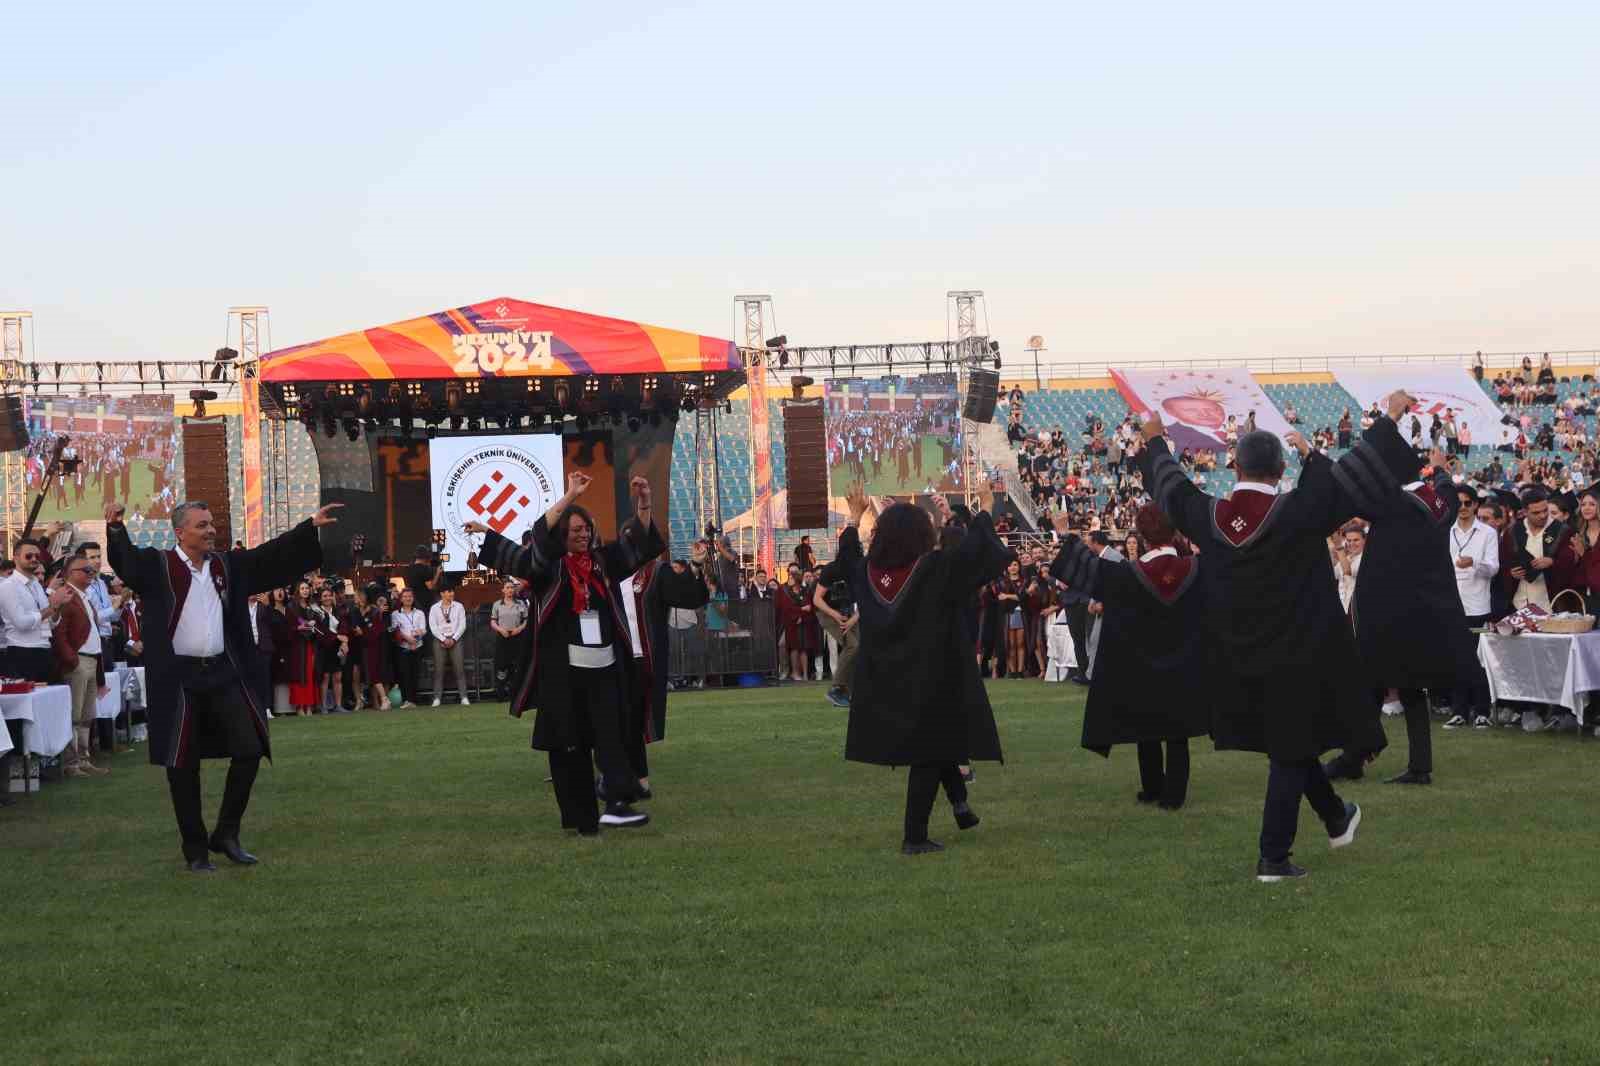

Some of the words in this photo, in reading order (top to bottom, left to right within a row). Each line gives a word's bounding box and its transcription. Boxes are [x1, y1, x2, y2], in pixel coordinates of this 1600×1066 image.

[453, 343, 554, 373] 2024
[446, 457, 475, 497] ESKİŞEHİR
[474, 448, 505, 462] TEKNİK
[505, 448, 552, 493] ÜNİVERSİTESİ
